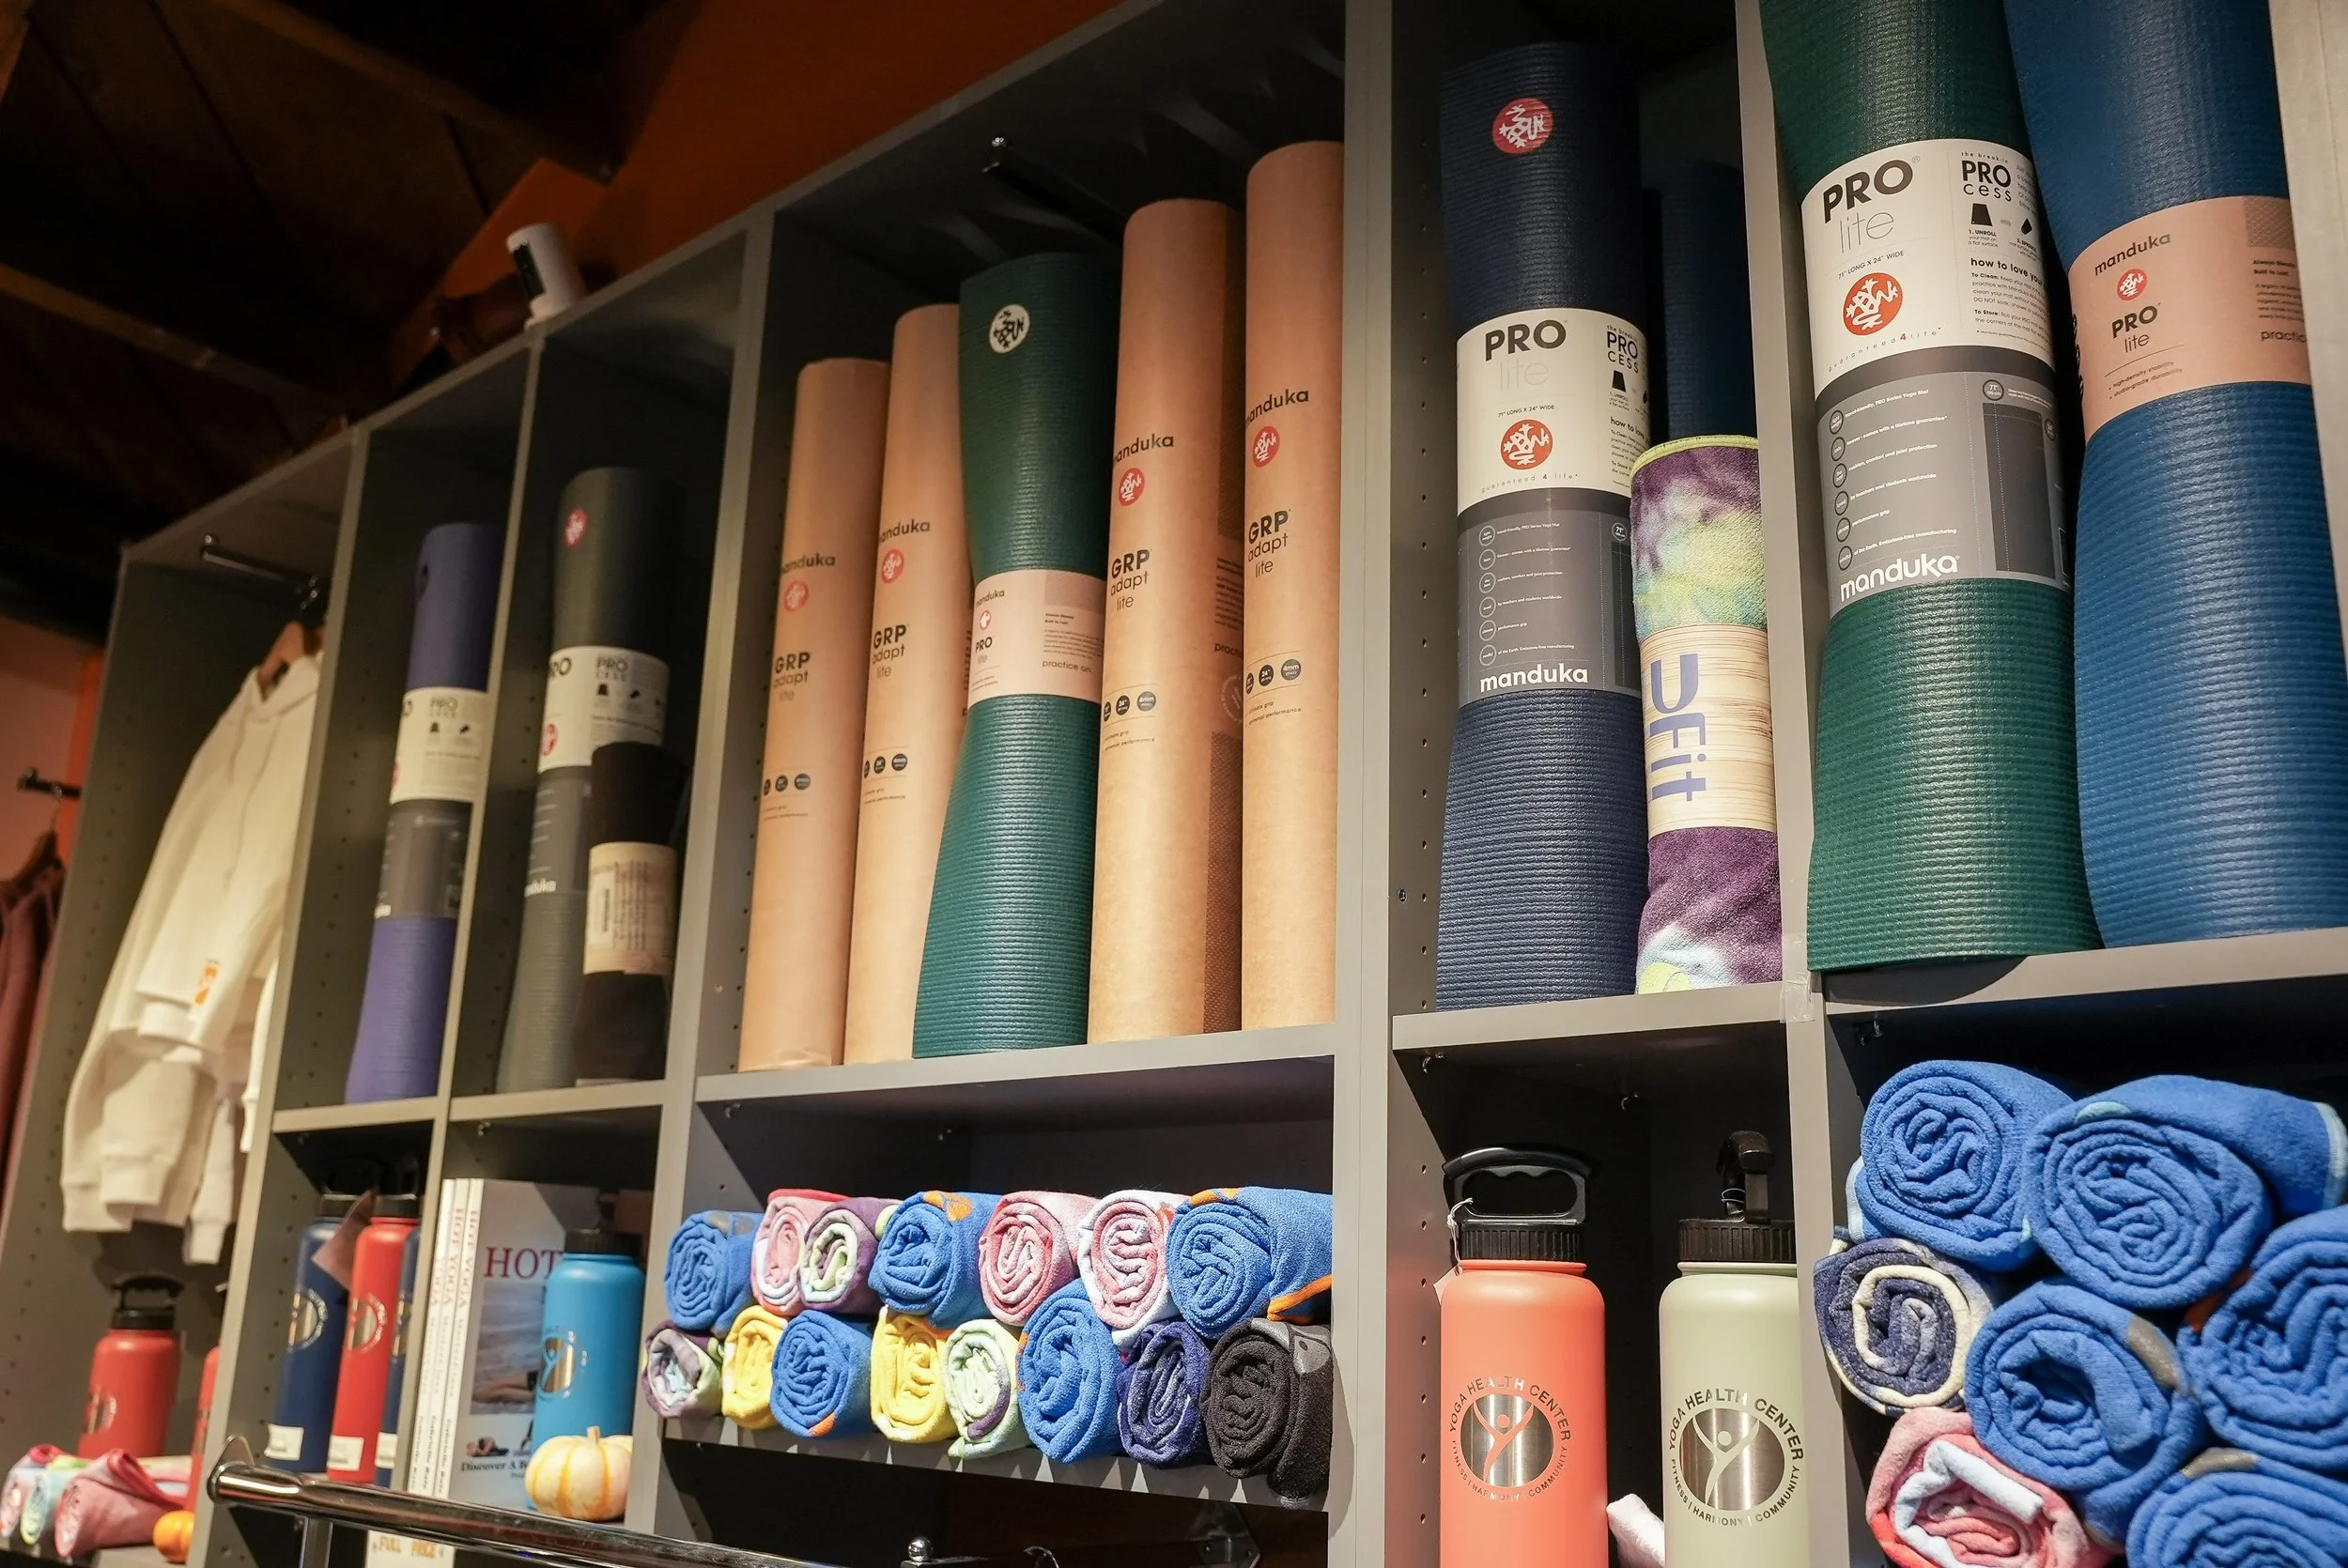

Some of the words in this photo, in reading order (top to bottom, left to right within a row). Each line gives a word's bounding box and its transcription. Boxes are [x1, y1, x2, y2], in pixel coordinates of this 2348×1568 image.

[1961, 160, 2012, 188] PRO
[1823, 160, 1913, 223] PRO
[1963, 184, 2012, 202] cess
[1839, 212, 1894, 254] lite
[1847, 262, 1866, 274] LONG
[1886, 250, 1905, 260] WIDE
[2094, 233, 2171, 276] manduka
[1970, 257, 1994, 268] how
[1997, 260, 2008, 270] to
[2010, 263, 2029, 277] love
[2111, 305, 2158, 339] PRO
[1485, 319, 1567, 361] PRO
[1607, 331, 1638, 360] PRO
[2124, 332, 2150, 354] lite
[1607, 350, 1639, 374] CESS
[1829, 338, 1896, 373] guaranteed
[1500, 358, 1549, 391] lite
[1886, 394, 1902, 403] Series
[1506, 407, 1522, 416] LONG
[1610, 416, 1626, 427] how
[1627, 423, 1634, 432] to
[1862, 429, 1878, 438] comes
[1894, 420, 1915, 428] lifetime
[1865, 453, 1885, 464] comfort
[1908, 443, 1938, 453] protection
[1480, 475, 1536, 494] guaranteed
[1875, 483, 1885, 491] and
[1885, 478, 1908, 487] students
[1908, 473, 1937, 482] worldwide
[1879, 509, 1891, 517] grip
[1248, 510, 1290, 545] GRP
[1915, 528, 1957, 538] manufacturing
[1247, 532, 1289, 562] adapt
[1111, 549, 1151, 579] GRP
[1255, 560, 1274, 578] lite
[1110, 571, 1150, 597] adapt
[1840, 553, 1958, 602] manduka
[1116, 595, 1135, 611] lite
[873, 624, 907, 650] GRP
[975, 636, 993, 654] PRO
[775, 652, 811, 674] GRP
[872, 644, 905, 665] adapt
[1042, 660, 1078, 670] practice
[773, 671, 809, 689] adapt
[876, 666, 892, 680] lite
[1479, 663, 1589, 693] manduka
[1265, 708, 1302, 718] performance
[1648, 653, 1707, 803] UFit
[484, 1247, 564, 1279] HOT
[1449, 1392, 1467, 1433] YOGA
[1467, 1376, 1525, 1395] HEALTH
[1529, 1384, 1571, 1441] CENTER
[1669, 1407, 1686, 1451] YOGA
[1684, 1388, 1748, 1410] HEALTH
[1753, 1398, 1804, 1461] CENTER
[1452, 1440, 1468, 1481] FITNESS
[1472, 1484, 1521, 1501] HARMONY
[1528, 1446, 1568, 1498] COMMUNITY
[1671, 1458, 1689, 1503] FITNESS
[1692, 1505, 1743, 1527] HARMONY
[1755, 1466, 1800, 1522] COMMUNITY
